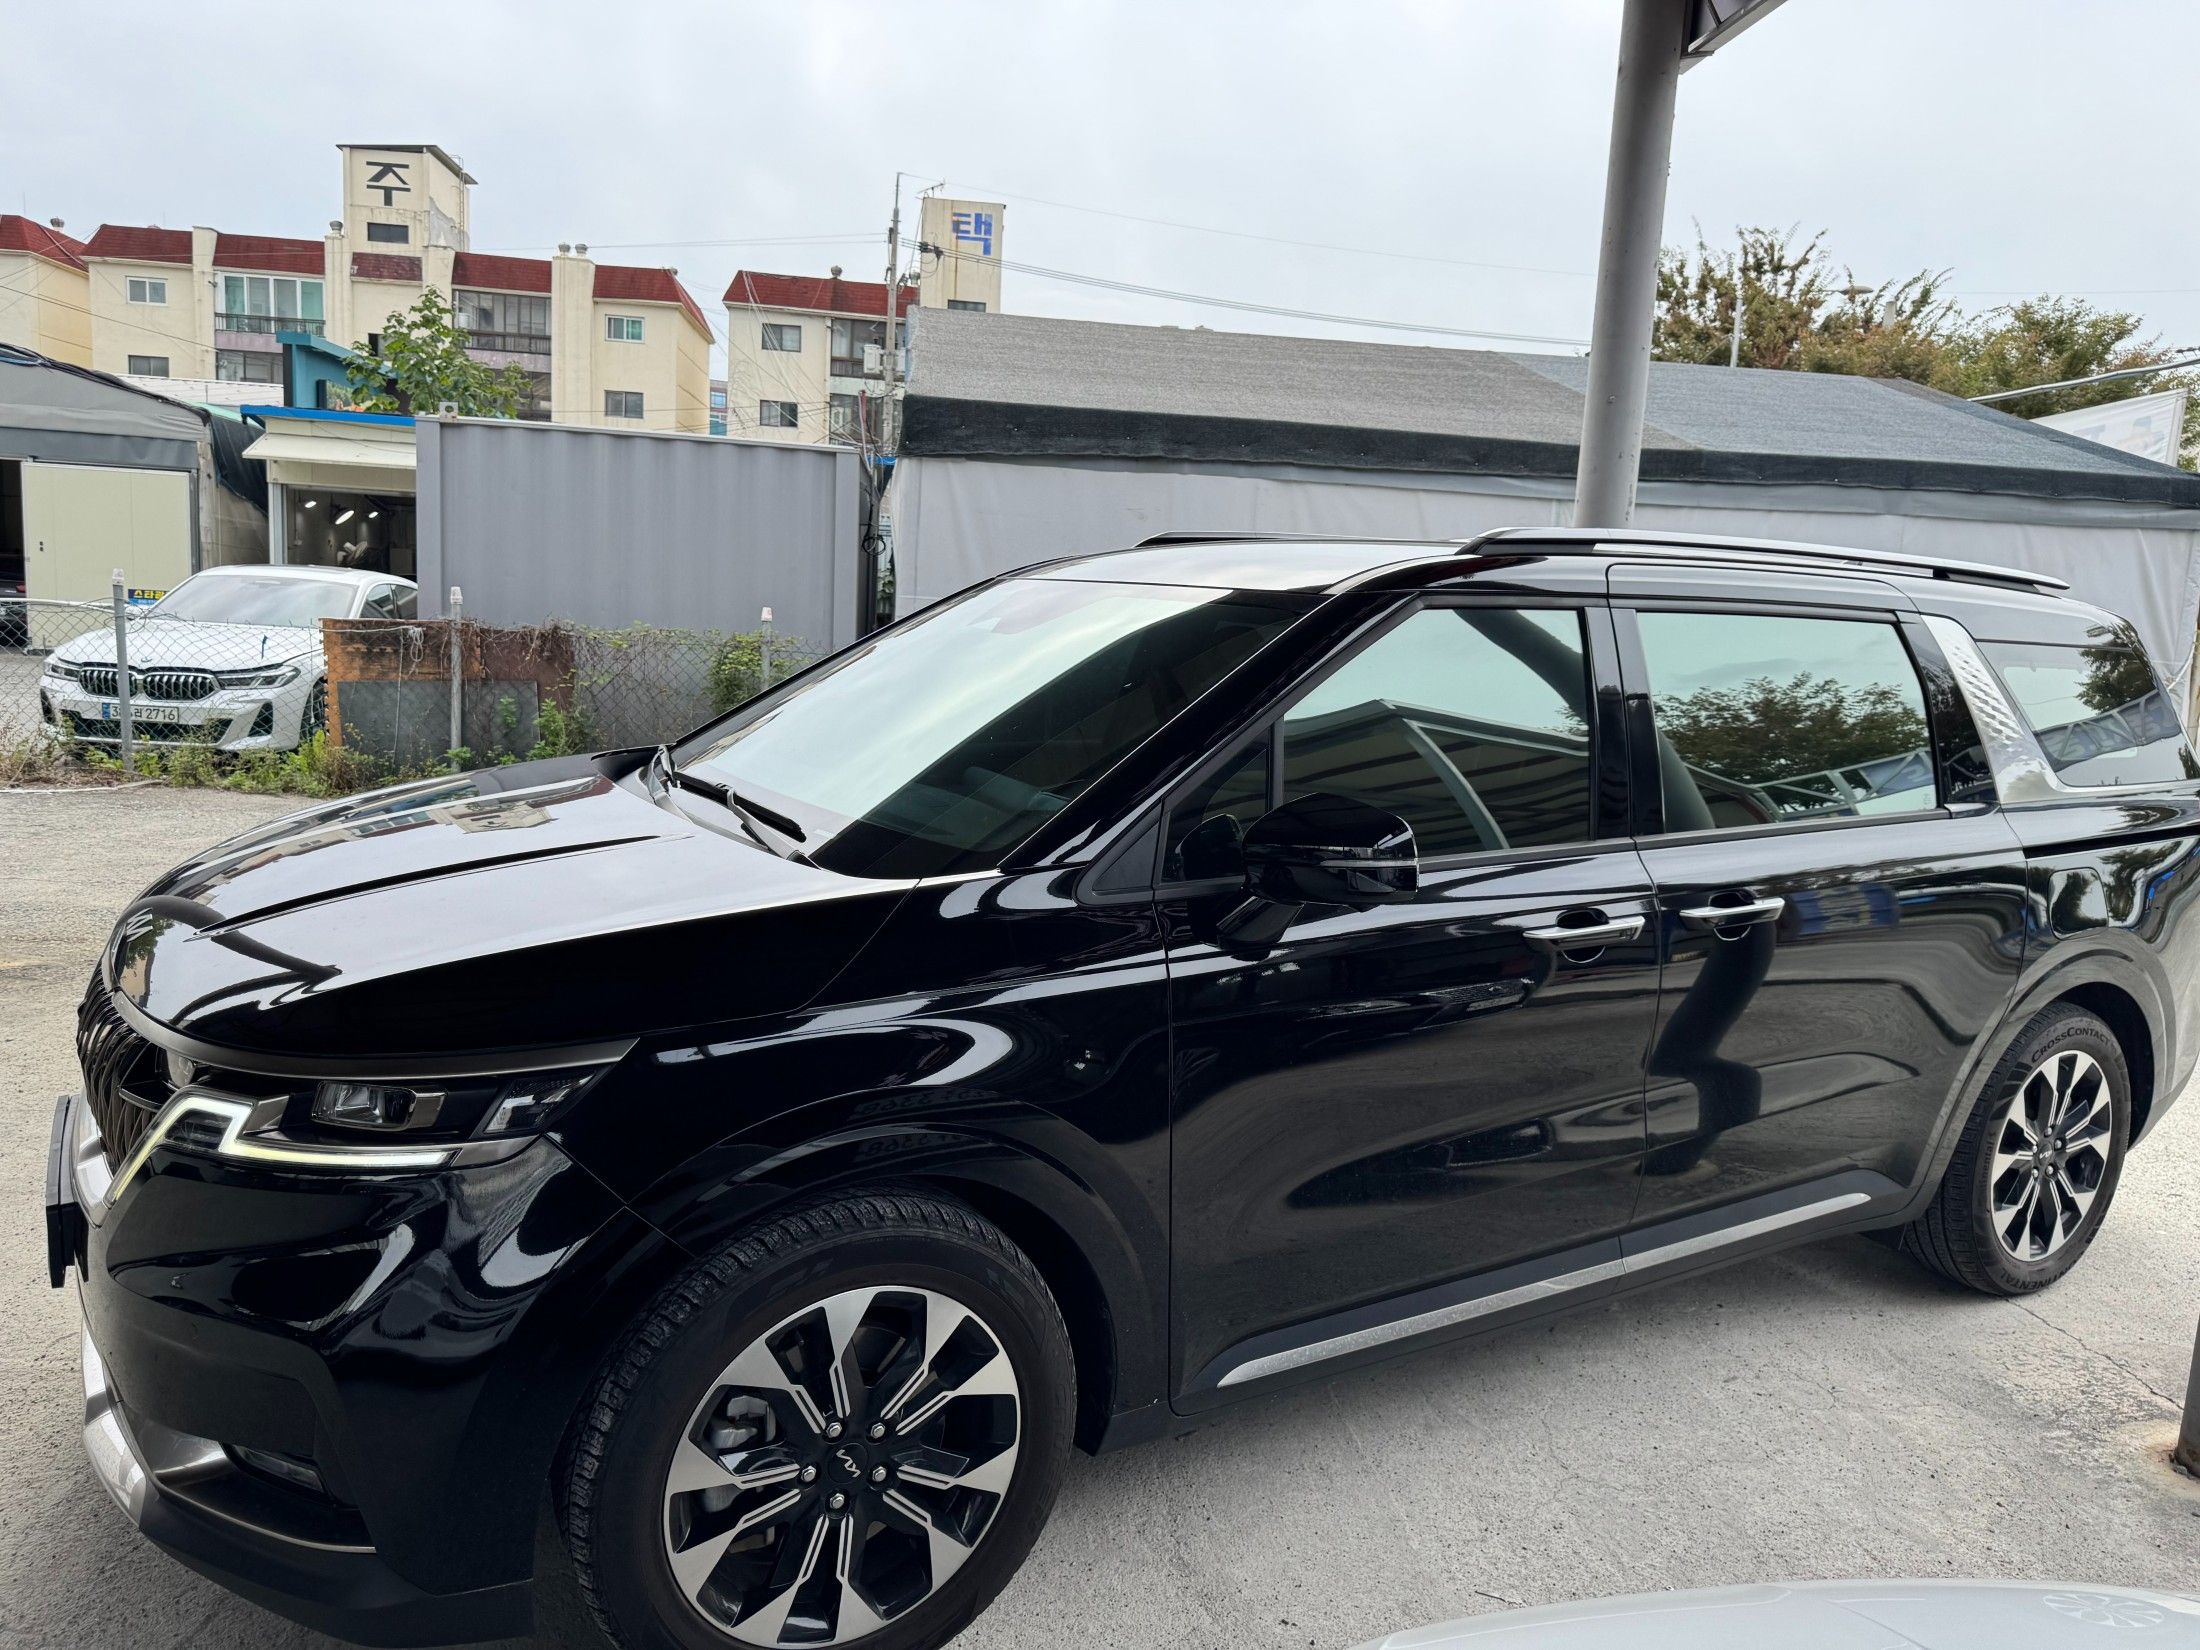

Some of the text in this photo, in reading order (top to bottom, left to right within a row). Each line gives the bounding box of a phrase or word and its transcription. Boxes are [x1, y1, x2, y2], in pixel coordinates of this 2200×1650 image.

[366, 161, 411, 206] 주
[952, 212, 993, 256] 택
[145, 707, 176, 720] 2716
